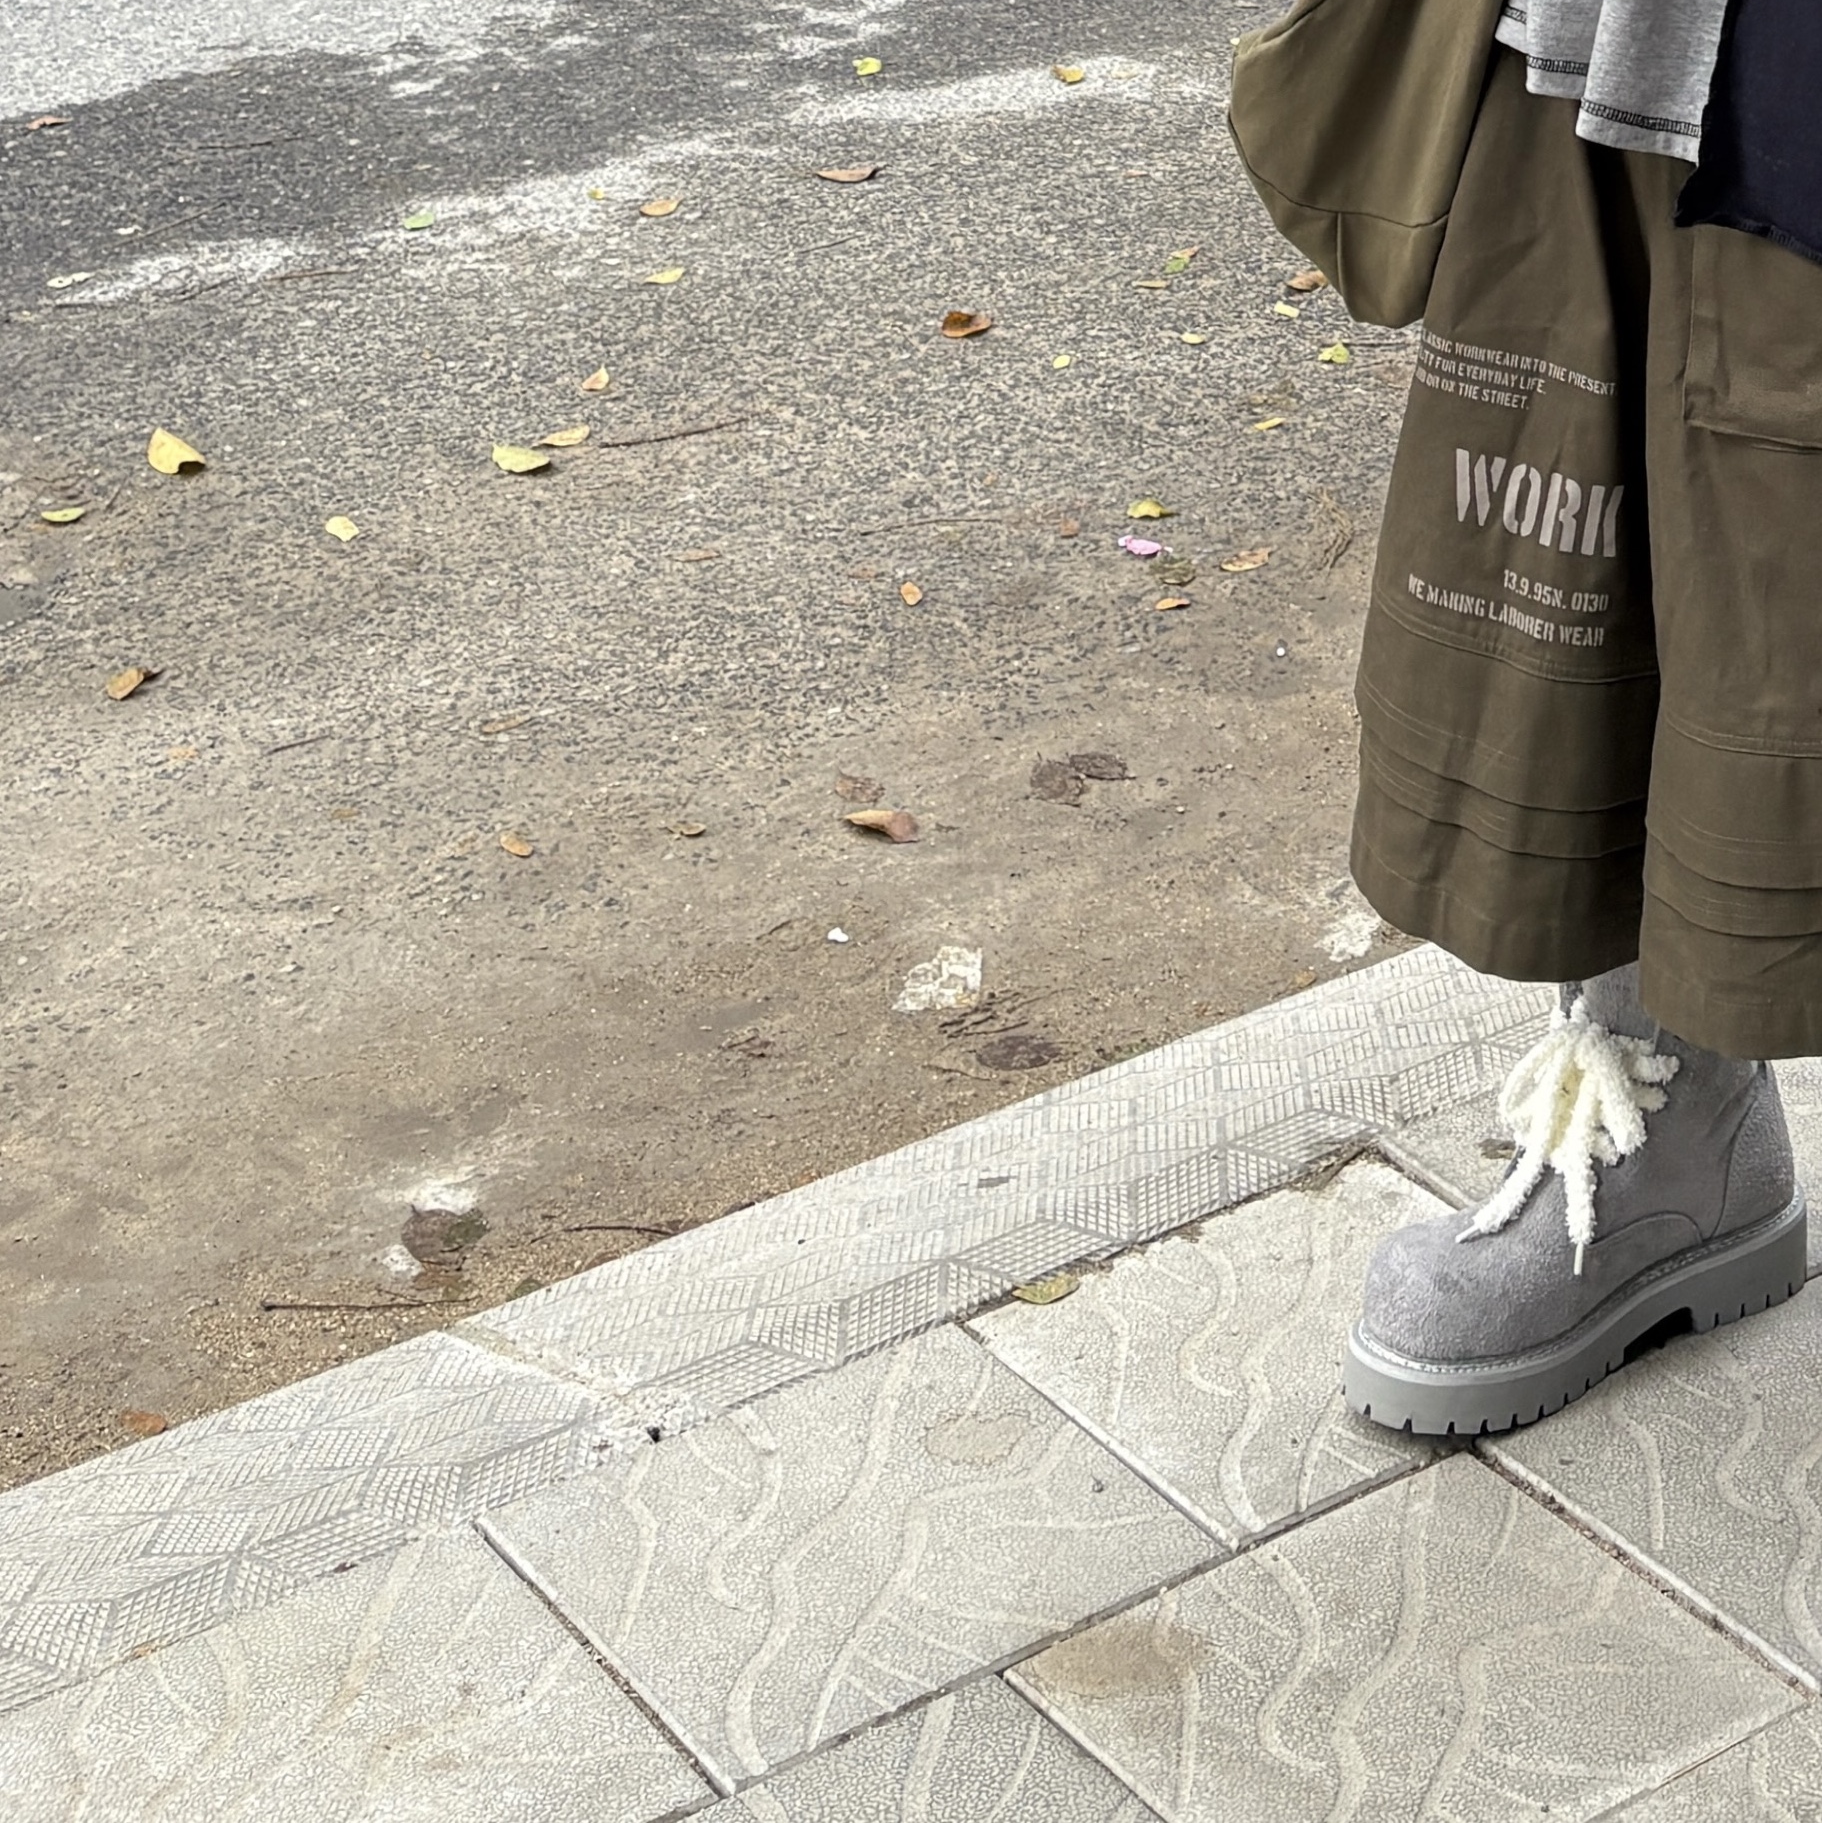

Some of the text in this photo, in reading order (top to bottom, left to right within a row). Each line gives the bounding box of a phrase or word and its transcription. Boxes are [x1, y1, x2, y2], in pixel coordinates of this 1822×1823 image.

[1421, 328, 1453, 354] LASSIC
[1455, 341, 1519, 369] WORKWEAR
[1548, 362, 1567, 382] THE
[1458, 362, 1518, 388] EVERYDAY
[1519, 376, 1547, 395] LIFE.
[1458, 382, 1479, 400] THE
[1481, 388, 1530, 410] STREET.
[1456, 448, 1625, 557] WORK
[1408, 573, 1605, 647] WE MAKING LABORER WEAR
